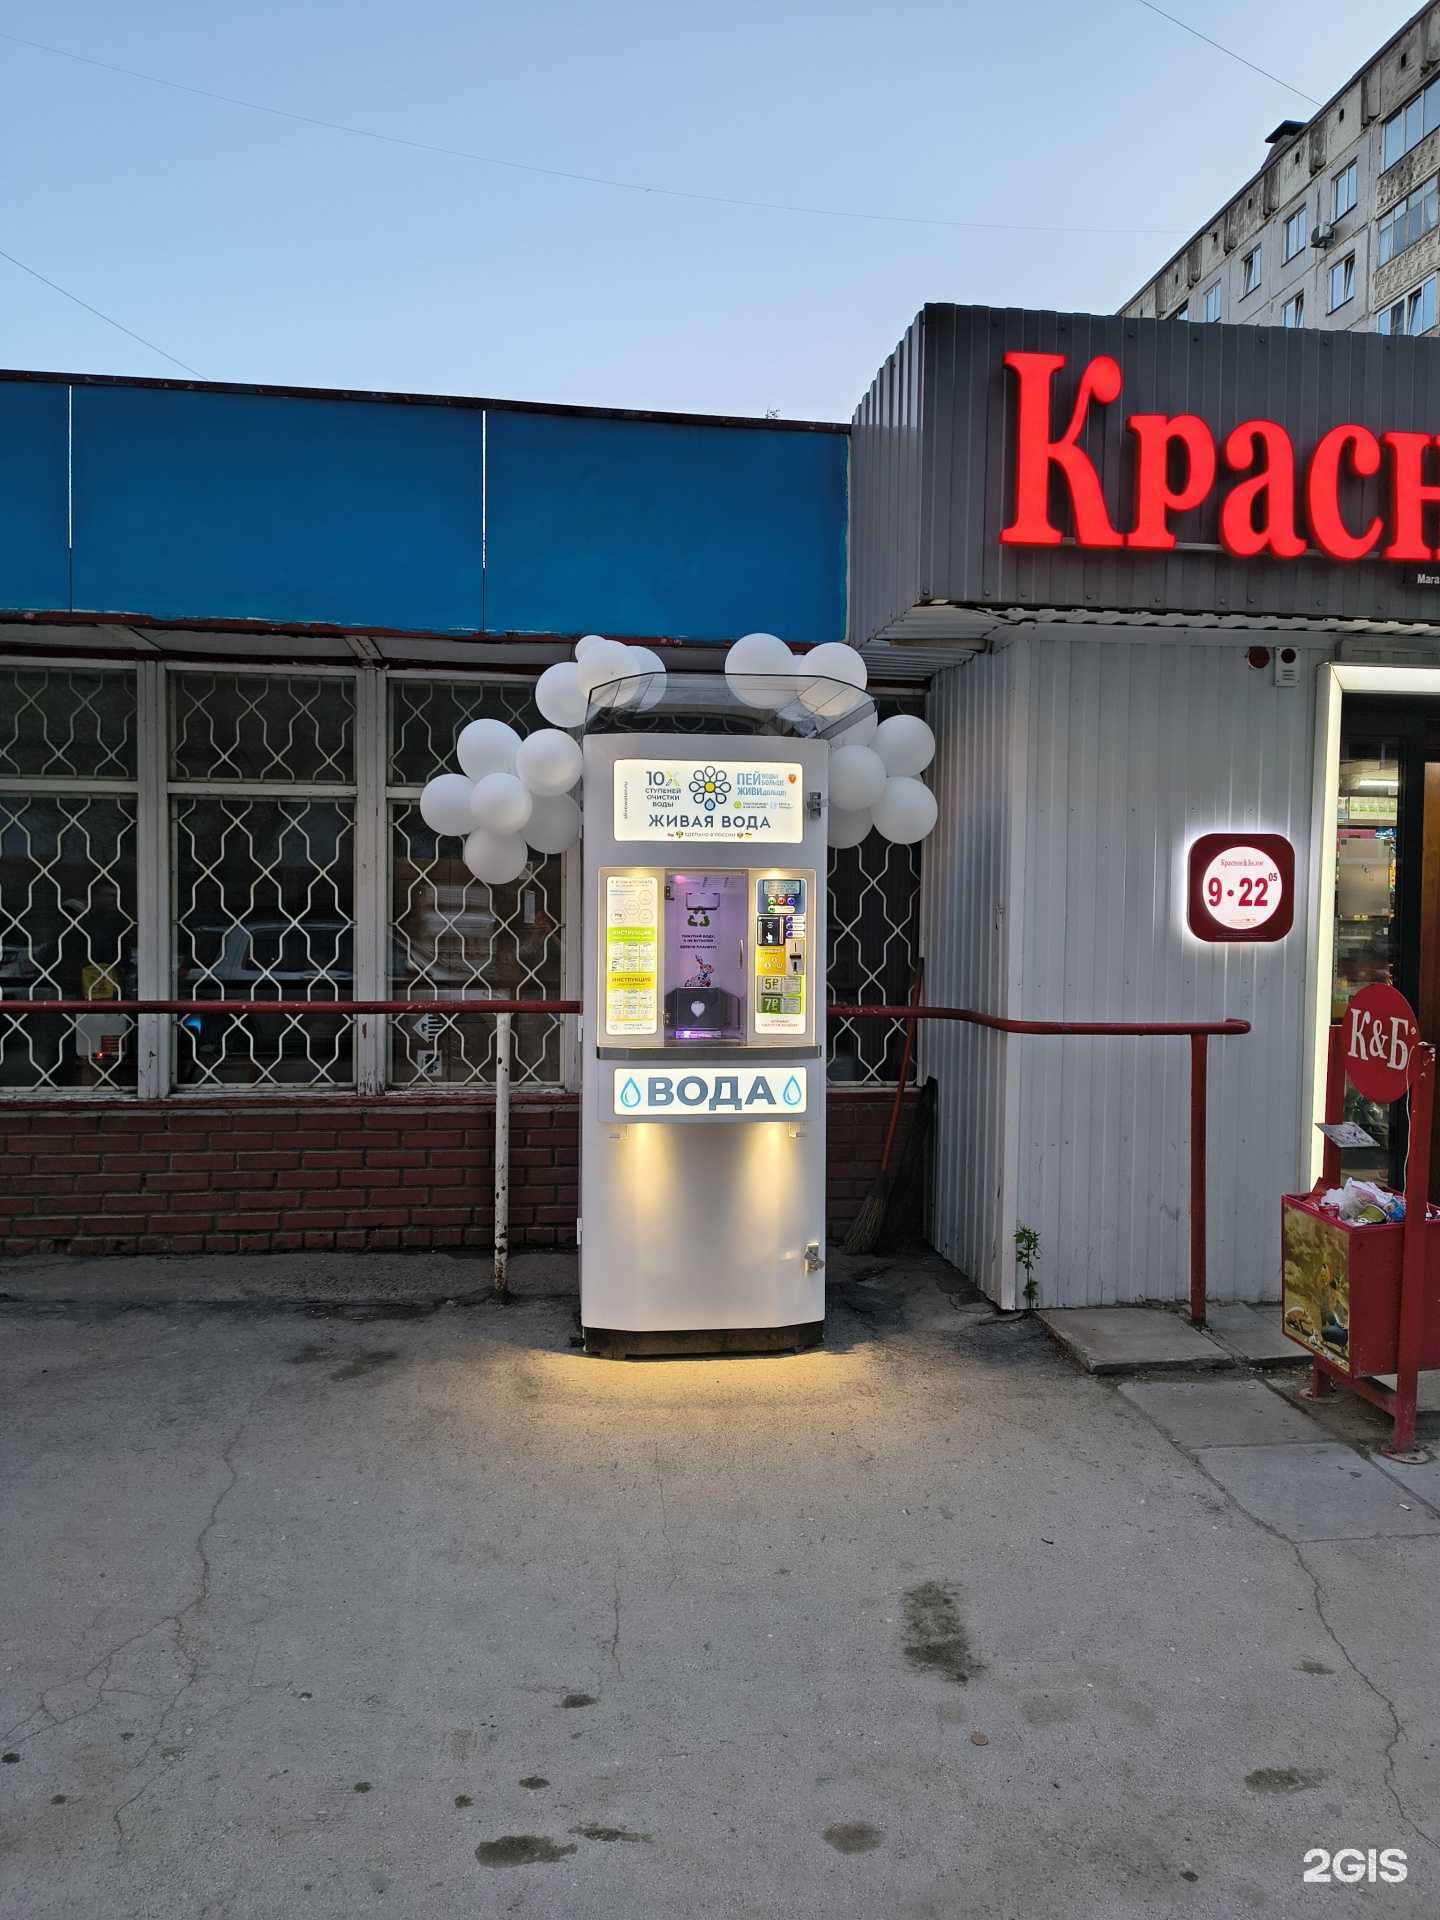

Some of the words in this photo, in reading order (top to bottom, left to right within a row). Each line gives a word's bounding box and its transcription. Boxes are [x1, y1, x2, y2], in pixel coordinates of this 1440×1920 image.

[645, 771, 665, 786] 10
[737, 770, 760, 785] ПЕЙ
[737, 787, 761, 795] ЖИВИ
[648, 814, 714, 828] ЖИВАЯ
[721, 815, 771, 830] ВОДА
[1269, 872, 1278, 882] 05
[1347, 1008, 1408, 1070] К&Б
[648, 1076, 777, 1111] ВОДА
